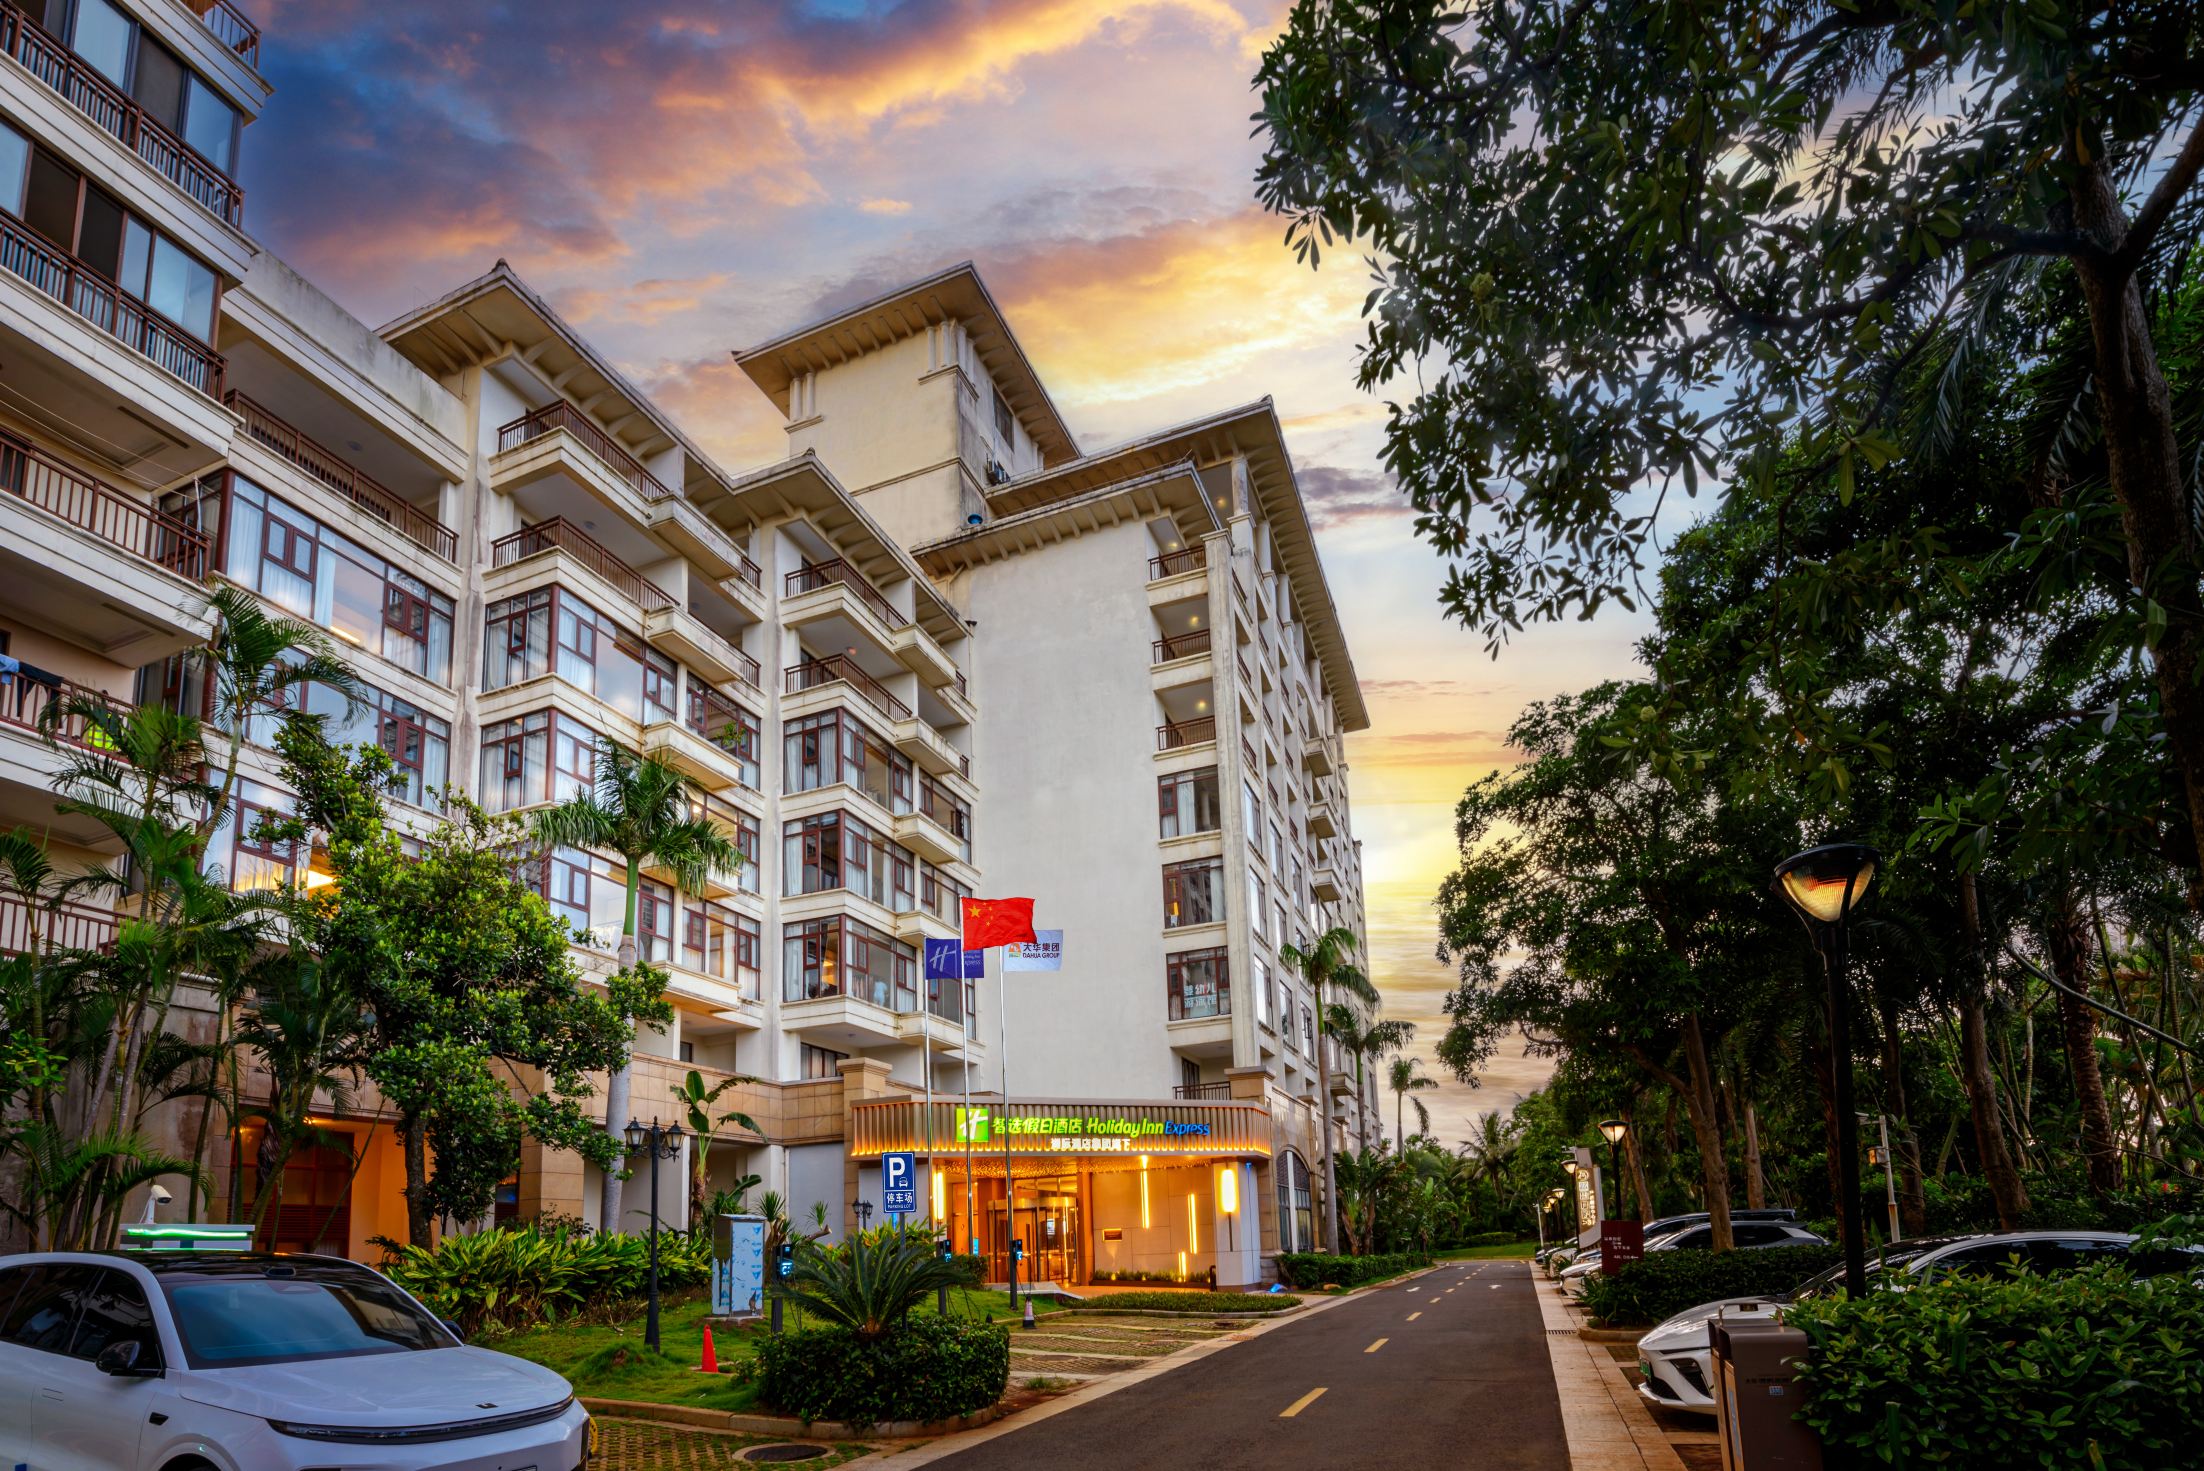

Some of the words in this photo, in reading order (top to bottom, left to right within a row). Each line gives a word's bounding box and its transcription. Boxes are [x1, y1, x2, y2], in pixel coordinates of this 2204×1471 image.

[1023, 943, 1060, 952] 大华集团
[993, 1117, 1083, 1134] 智选假日酒店
[1087, 1117, 1140, 1138] Holiday
[1142, 1118, 1164, 1134] Inn
[1164, 1120, 1211, 1136] Express
[889, 1157, 906, 1187] P
[887, 1192, 913, 1204] 停车场
